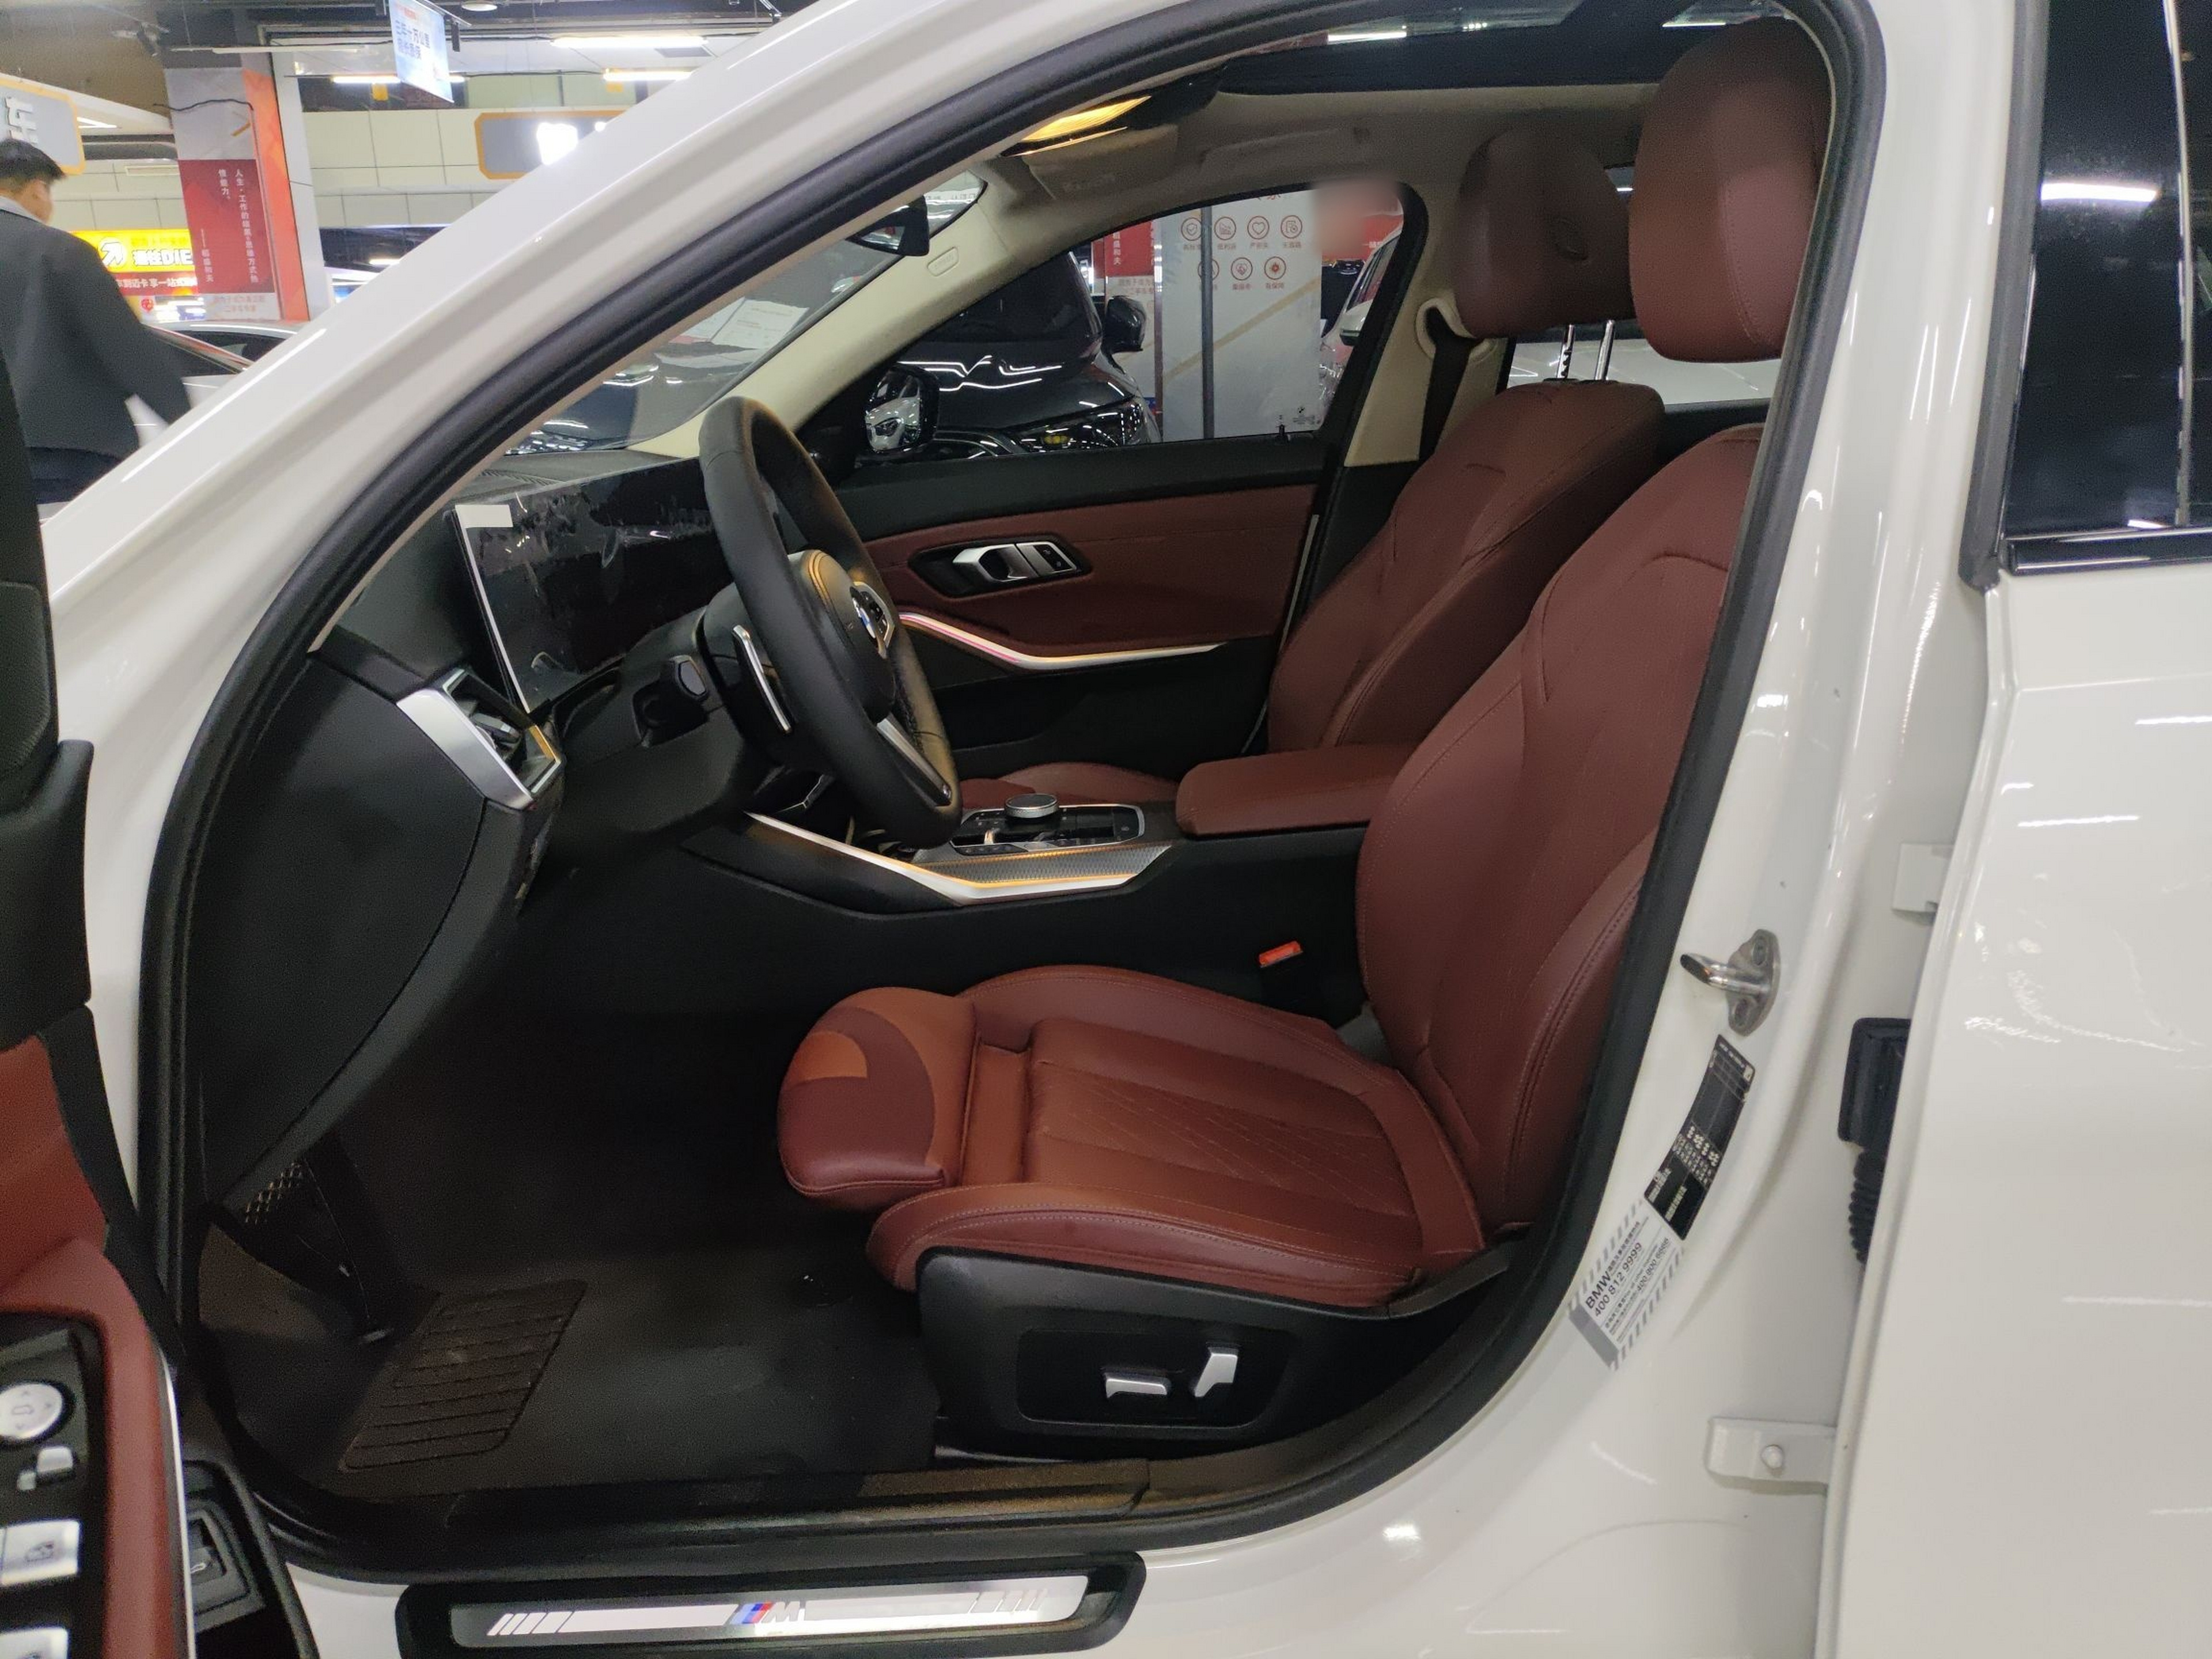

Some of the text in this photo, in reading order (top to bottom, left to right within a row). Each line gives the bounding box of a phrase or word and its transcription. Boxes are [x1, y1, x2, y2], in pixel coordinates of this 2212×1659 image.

[1584, 1270, 1612, 1309] BMW
[1593, 1293, 1610, 1317] 400
[1607, 1271, 1624, 1295] 812
[1621, 1241, 1642, 1272] 9999
